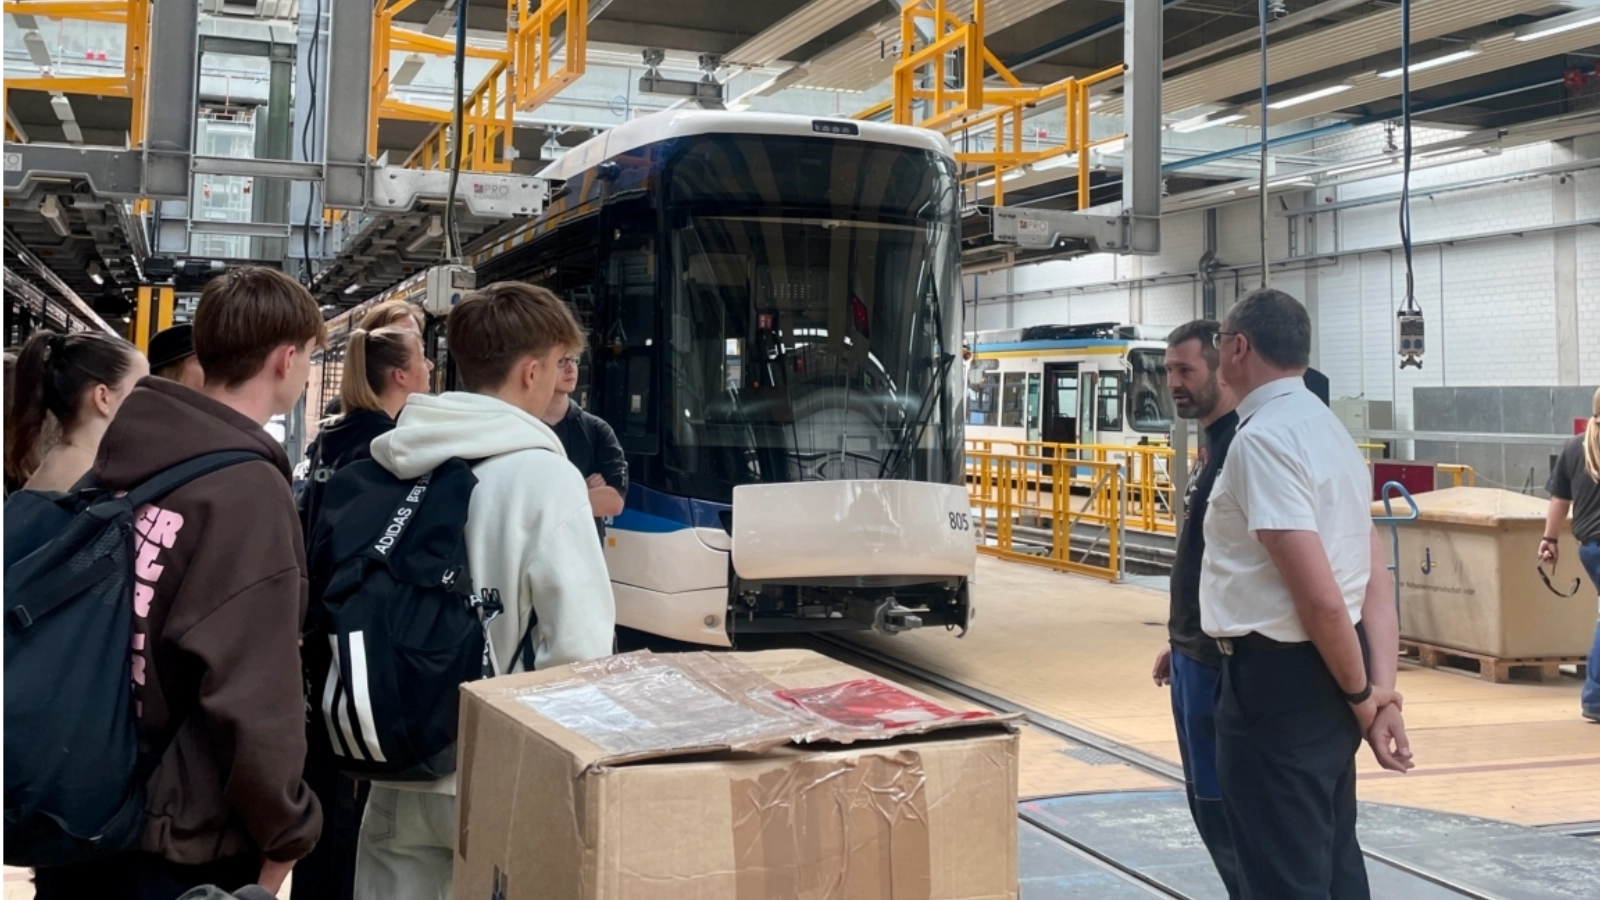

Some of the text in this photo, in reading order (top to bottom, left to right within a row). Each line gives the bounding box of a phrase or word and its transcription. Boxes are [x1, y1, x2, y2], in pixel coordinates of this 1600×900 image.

[484, 184, 510, 195] PRO
[1027, 221, 1047, 230] PRO
[949, 511, 969, 531] 805
[374, 507, 413, 555] ADIDAS
